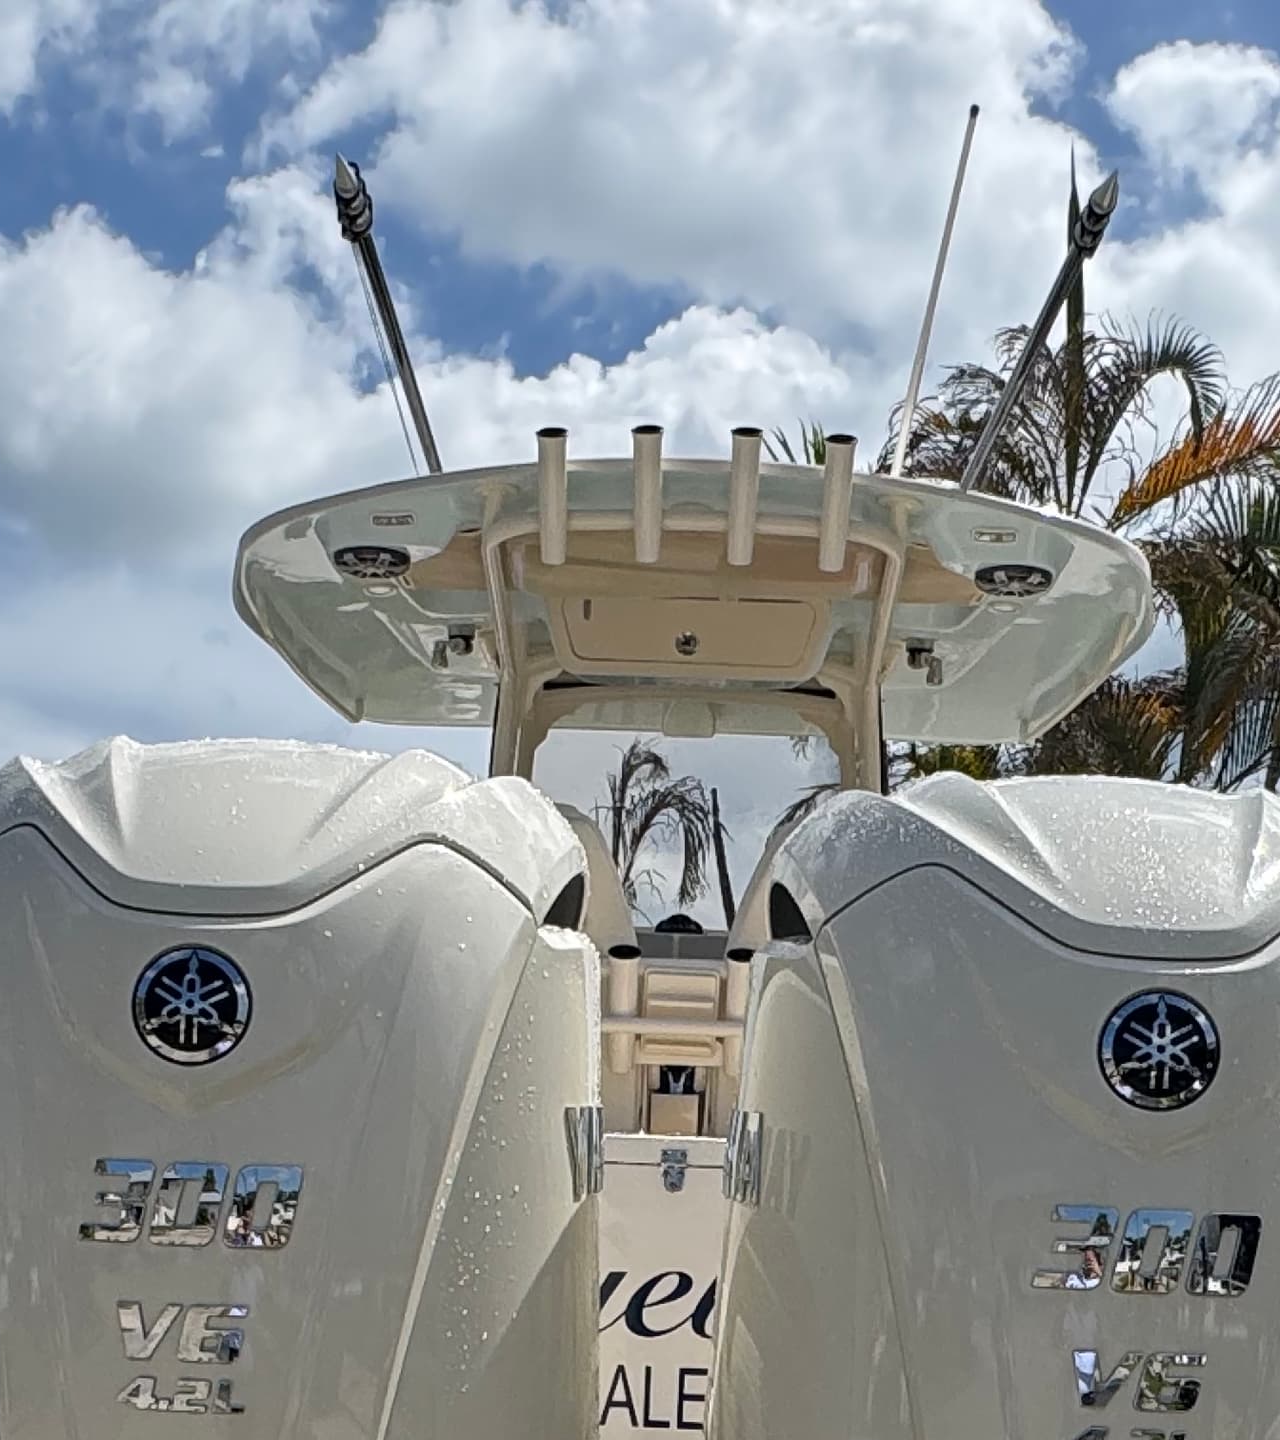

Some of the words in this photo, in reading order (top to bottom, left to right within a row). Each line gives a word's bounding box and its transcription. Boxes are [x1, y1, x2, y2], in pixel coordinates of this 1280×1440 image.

[79, 1158, 304, 1249] 300
[1030, 1204, 1263, 1296] 300
[118, 1301, 249, 1363] V6
[118, 1376, 244, 1413] 4.2L
[1072, 1350, 1207, 1411] V6
